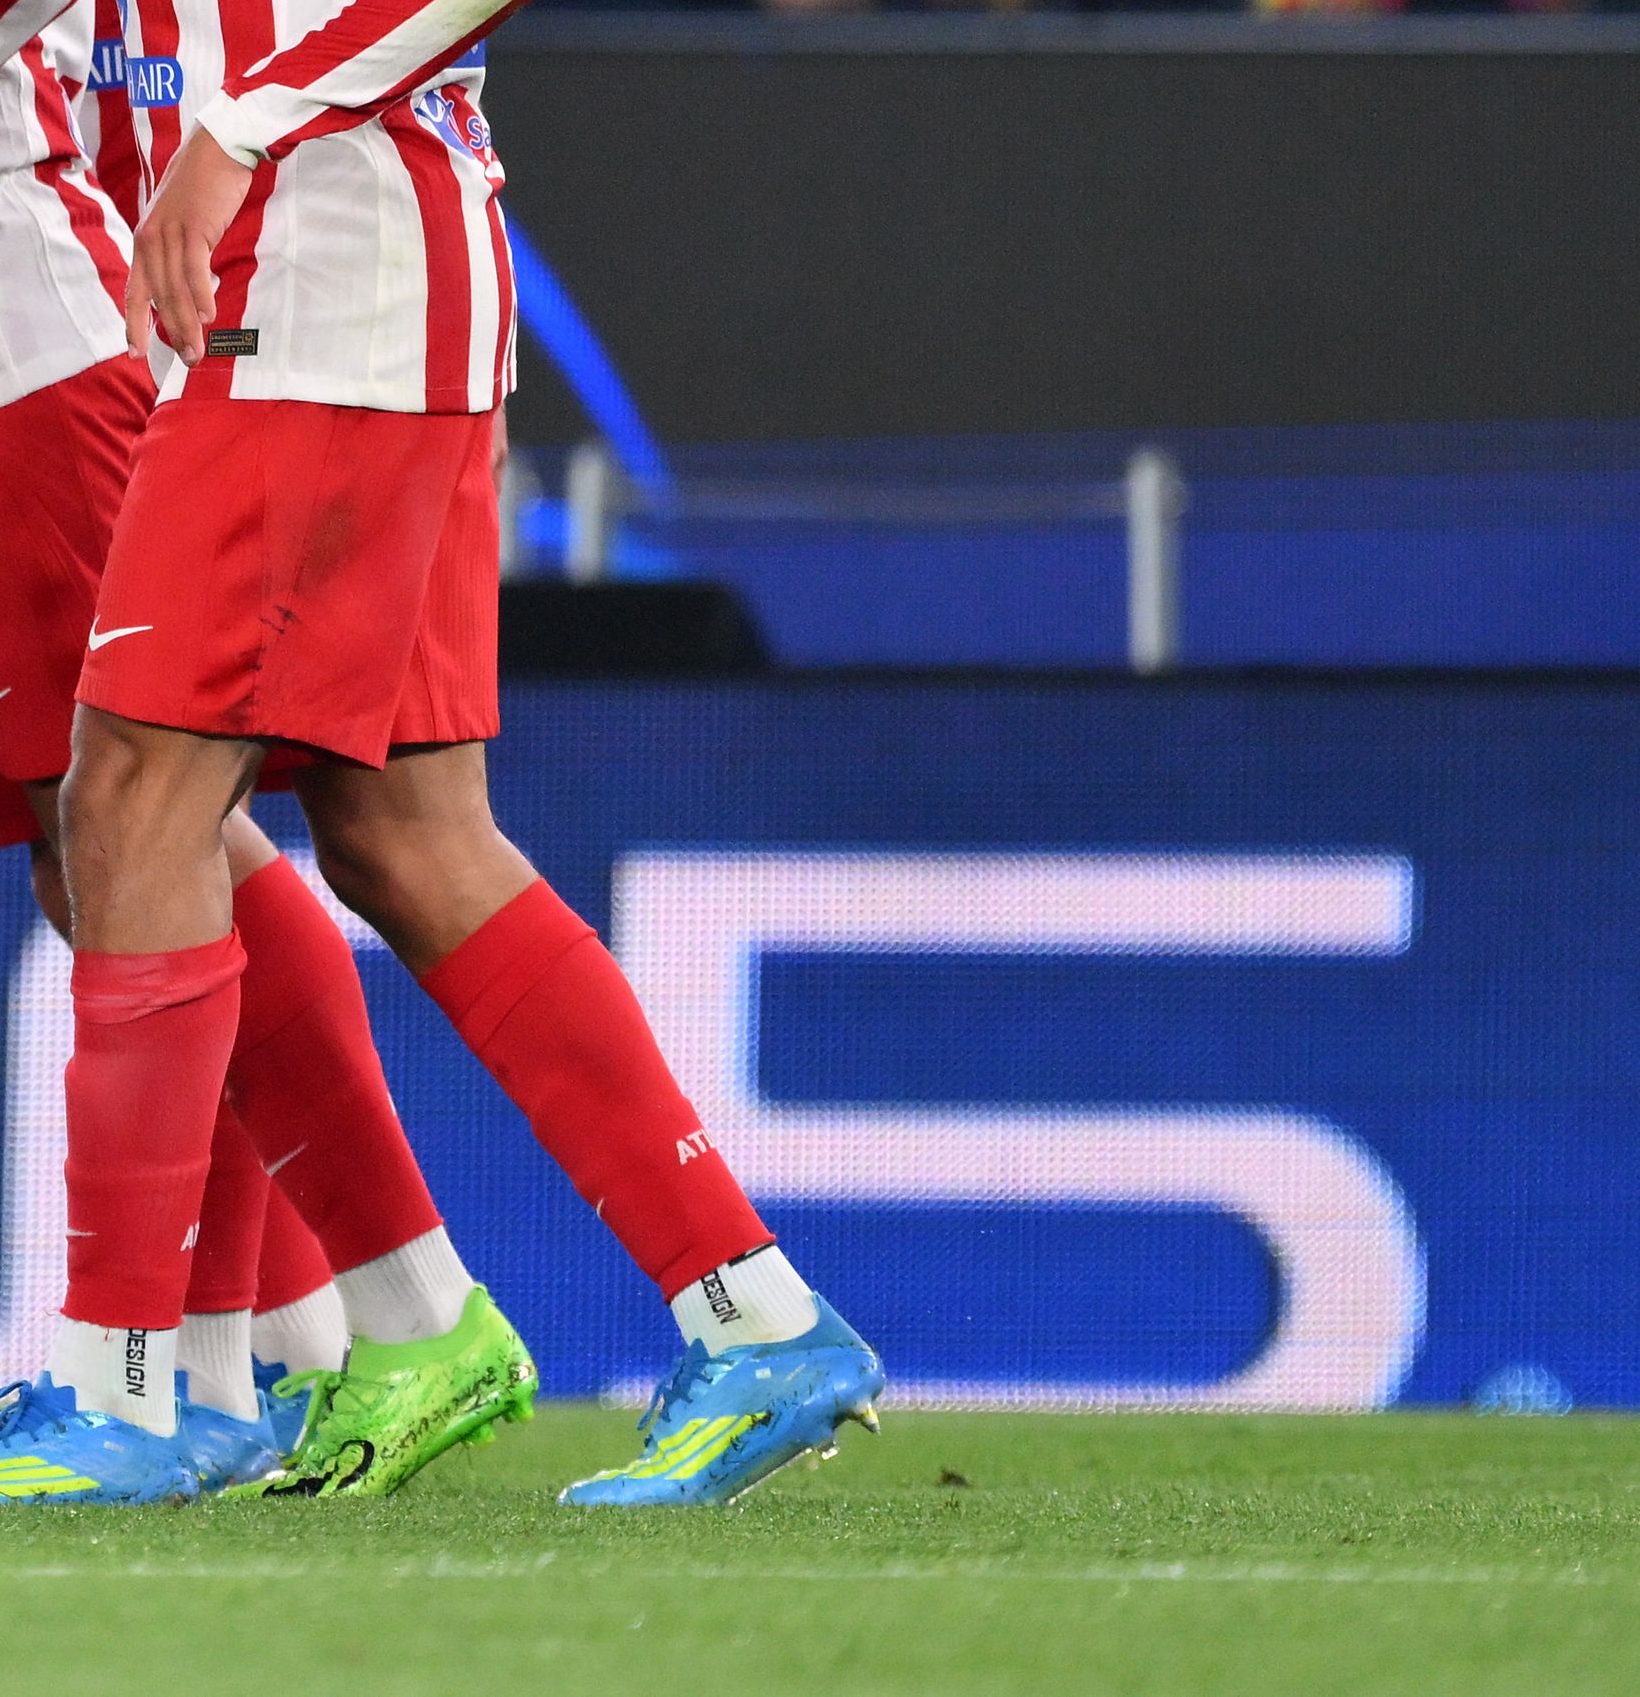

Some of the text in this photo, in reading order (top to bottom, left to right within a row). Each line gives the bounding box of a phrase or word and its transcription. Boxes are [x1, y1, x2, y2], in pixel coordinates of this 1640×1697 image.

[137, 63, 178, 101] AIR
[700, 1267, 742, 1324] DESIGN
[125, 1328, 147, 1398] DESIGN
